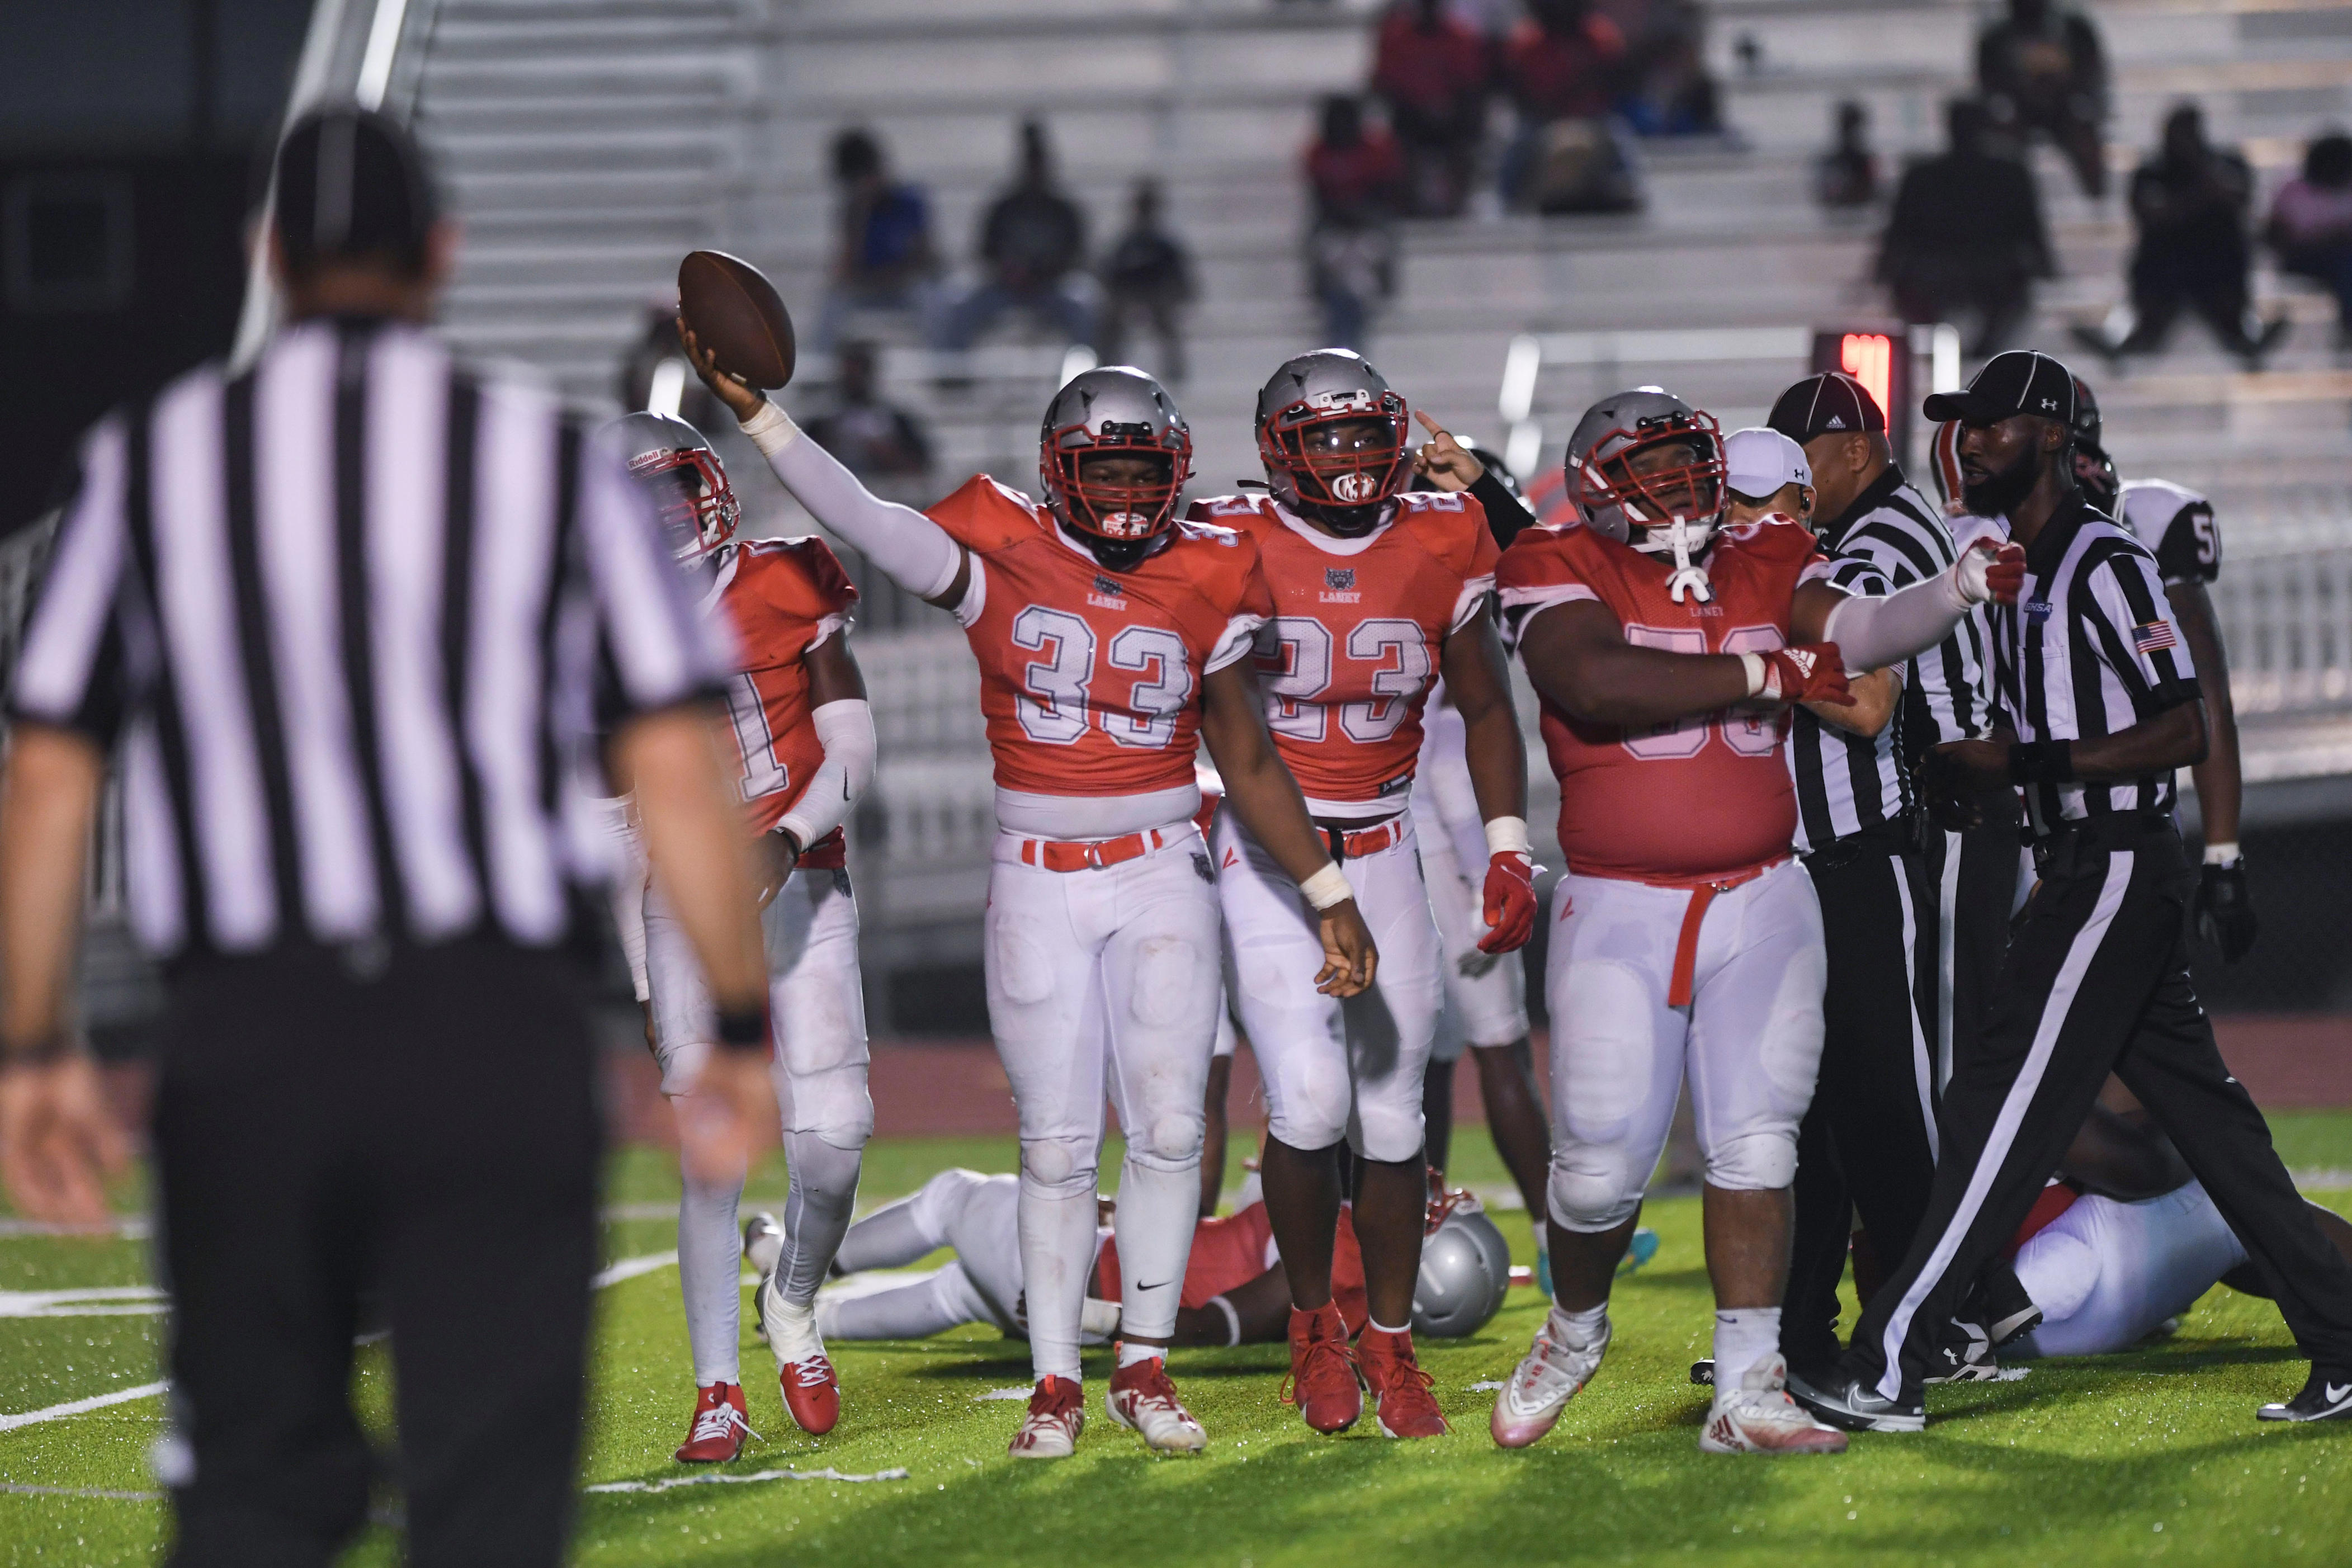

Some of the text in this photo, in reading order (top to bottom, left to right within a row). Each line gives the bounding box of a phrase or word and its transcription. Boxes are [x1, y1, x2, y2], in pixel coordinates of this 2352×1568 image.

[629, 451, 659, 467] Riddell
[1087, 593, 1127, 611] LANEY
[1319, 591, 1362, 603] LANEY
[1783, 649, 1811, 679] adidas
[1012, 604, 1193, 749] 33
[1253, 616, 1431, 744] 23
